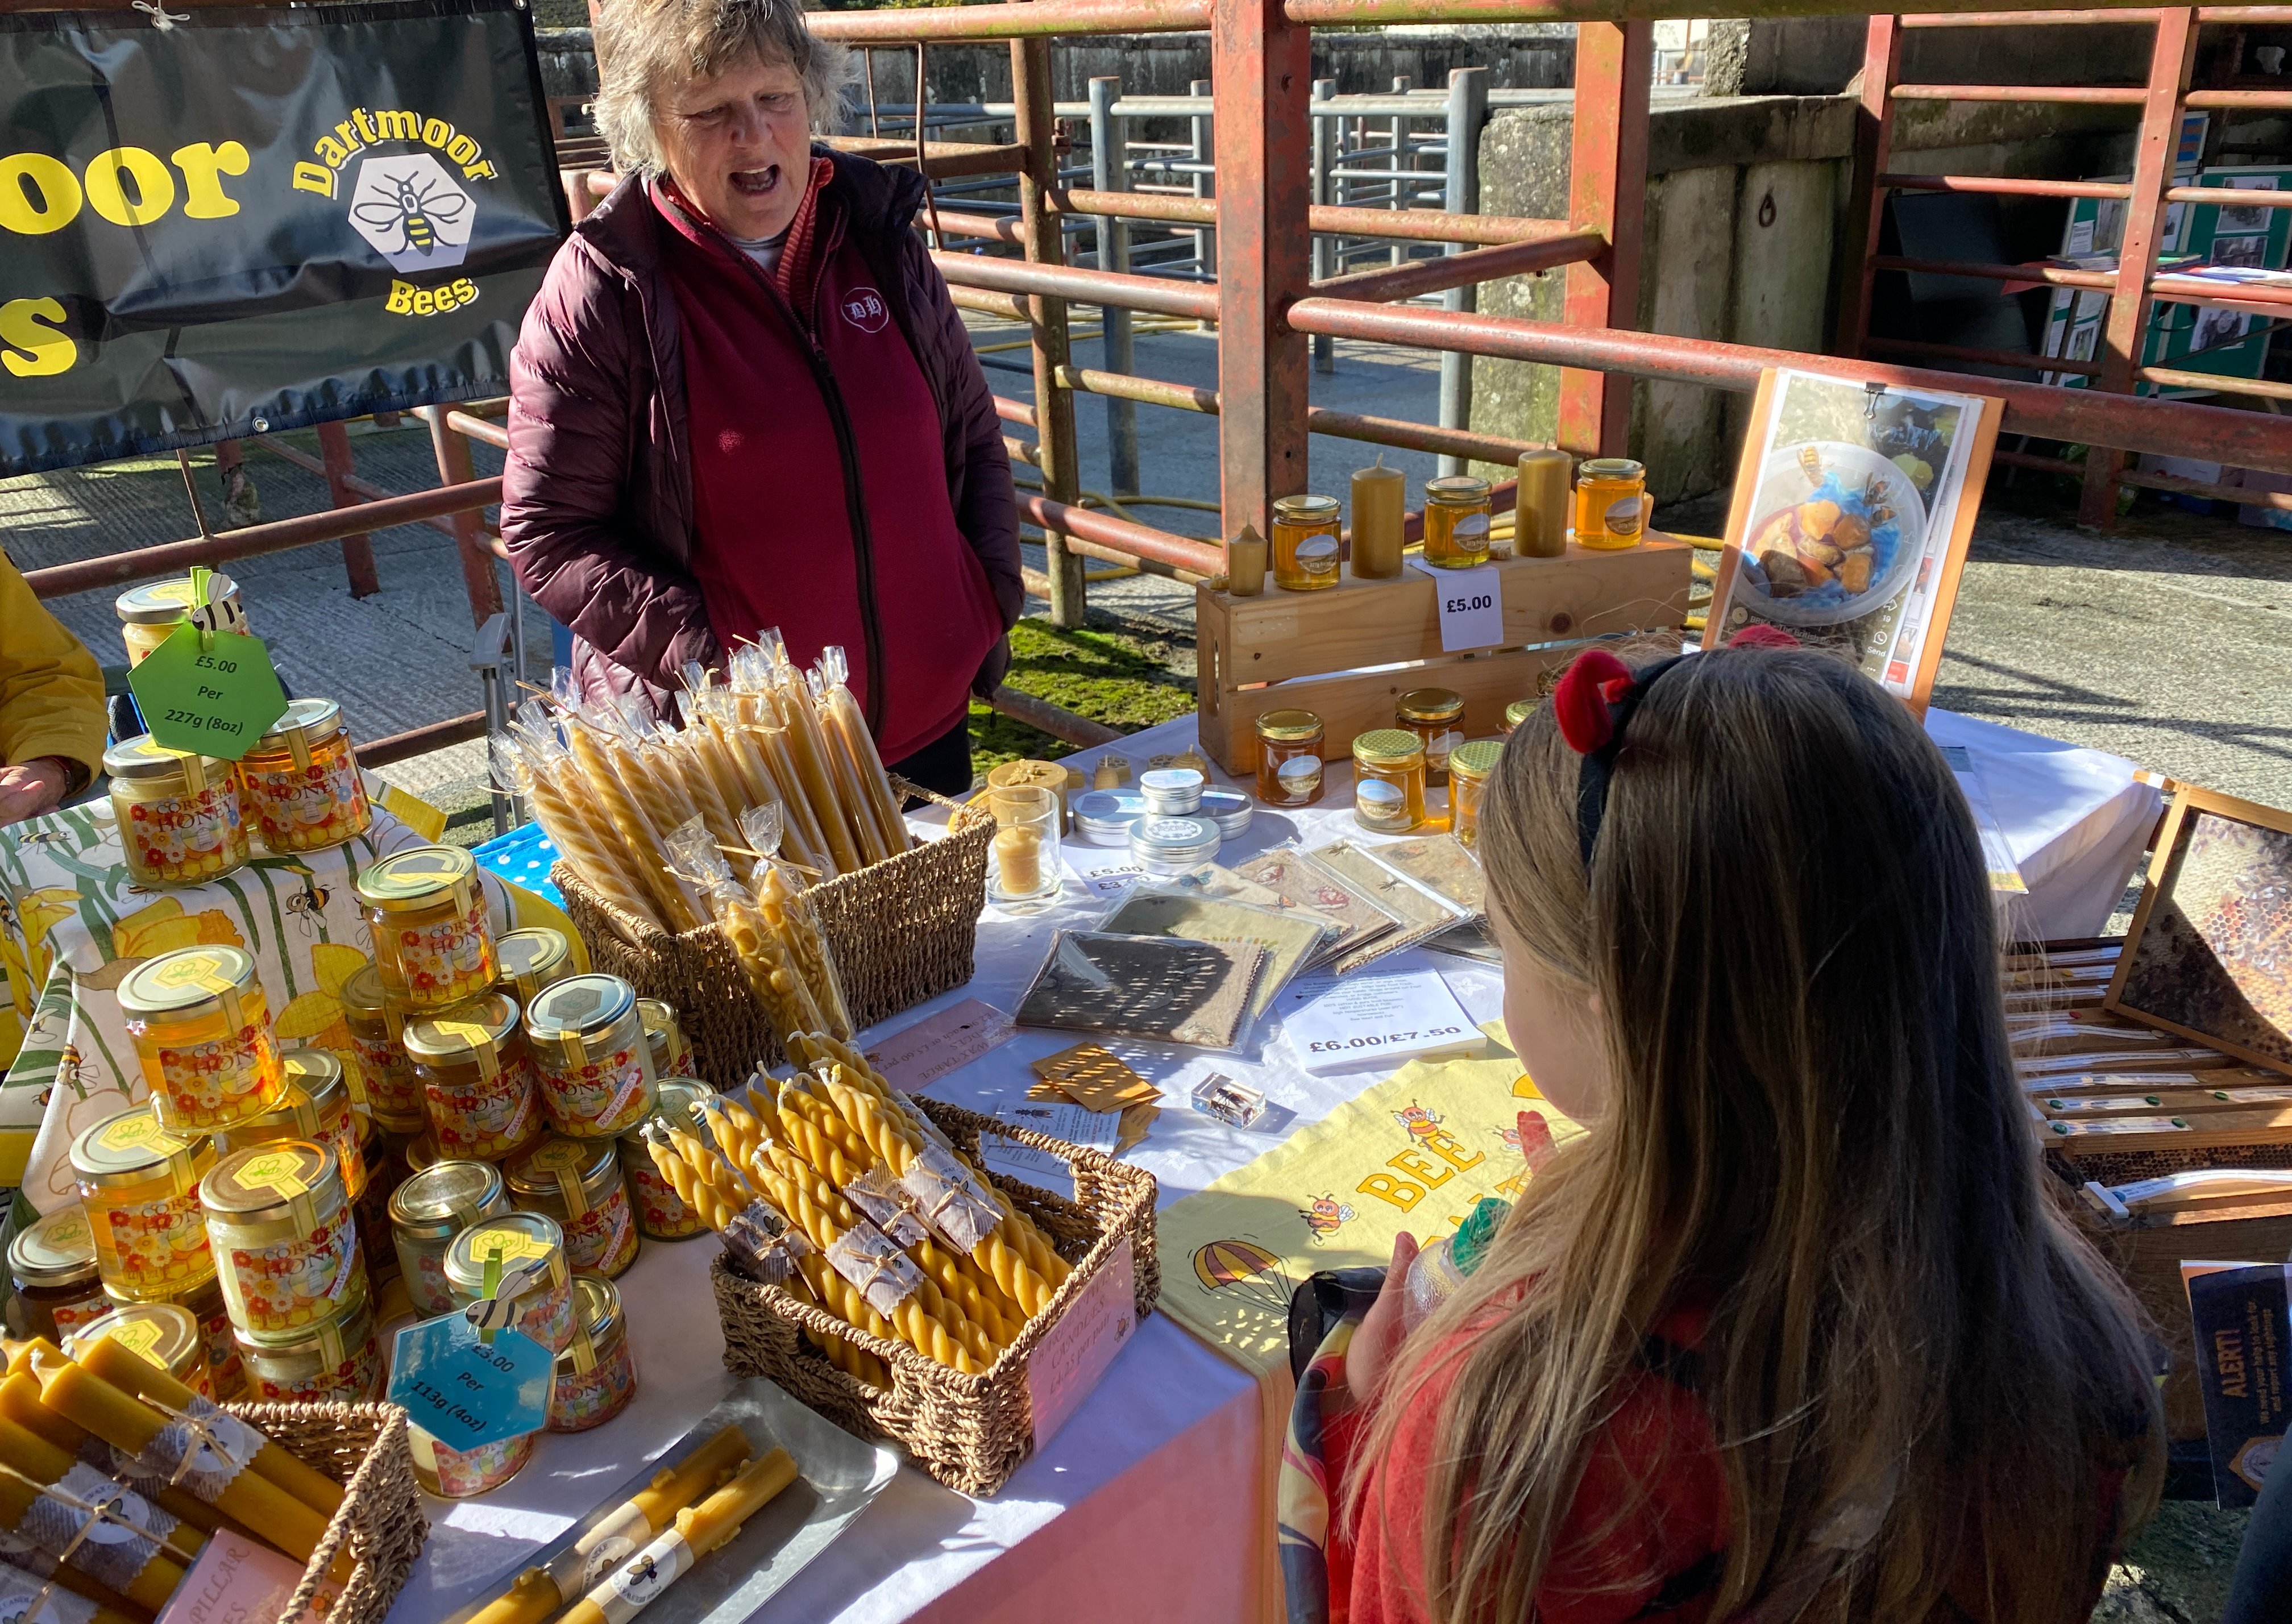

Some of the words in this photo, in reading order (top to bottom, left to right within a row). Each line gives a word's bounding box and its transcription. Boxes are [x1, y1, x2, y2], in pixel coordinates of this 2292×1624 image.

[292, 107, 495, 199] Dartmoor
[385, 277, 479, 316] Bees
[1447, 595, 1492, 613] £5.00
[194, 655, 237, 673] £5.00
[1867, 646, 1886, 657] Send
[197, 686, 223, 699] Per
[164, 709, 203, 728] 227g
[206, 716, 243, 736] (8oz)
[268, 773, 342, 803] HONEY
[157, 796, 232, 833] HONEY
[1090, 865, 1144, 877] £5.00
[1310, 1027, 1461, 1052] £6.00/£7.50
[883, 1060, 899, 1071] per
[917, 1056, 960, 1081] TABLE
[548, 1068, 621, 1096] HONEY
[599, 1108, 616, 1126] RAW
[616, 1075, 636, 1108] HONEY
[508, 1116, 523, 1137] RAW
[1356, 1131, 1485, 1213] BEE
[602, 1246, 616, 1267] RAW
[616, 1212, 628, 1244] HONEY
[331, 1272, 346, 1297] RAW
[1052, 1295, 1105, 1369] CANDLES
[1093, 1313, 1111, 1345] pair
[471, 1344, 515, 1372] £3.00
[2215, 1328, 2248, 1397] ALERT!
[456, 1371, 484, 1392] Per
[410, 1380, 448, 1409] 113g
[446, 1404, 487, 1432] (4oz)
[189, 1548, 250, 1624] PILLAR
